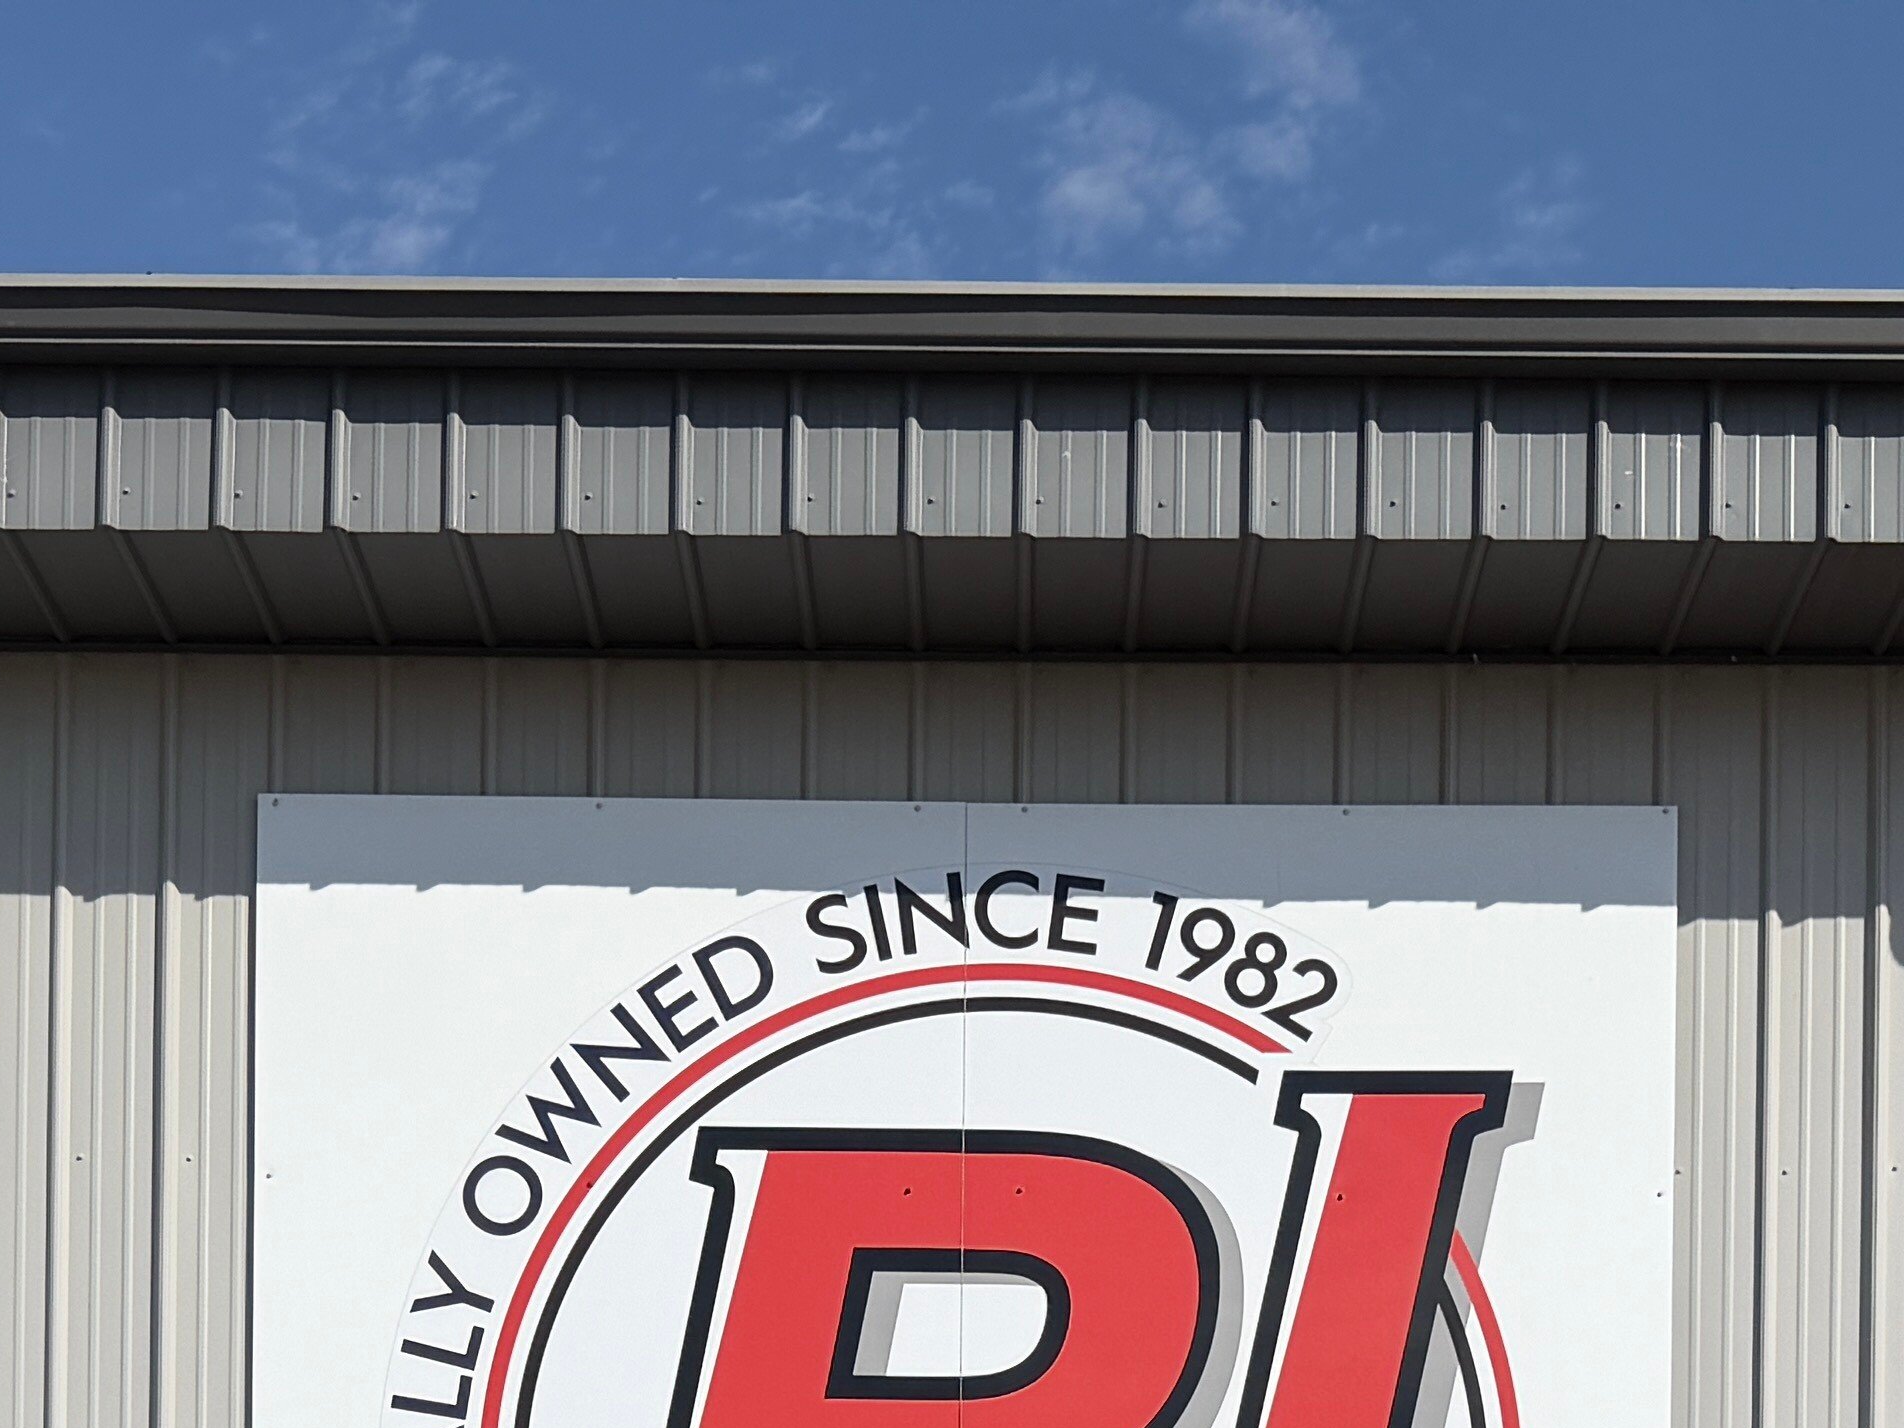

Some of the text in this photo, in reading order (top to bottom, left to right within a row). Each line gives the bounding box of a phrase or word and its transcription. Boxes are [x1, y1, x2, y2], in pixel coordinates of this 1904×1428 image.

[462, 935, 774, 1236] OWNED
[805, 869, 1106, 974] SINCE
[1145, 890, 1338, 1042] 1982
